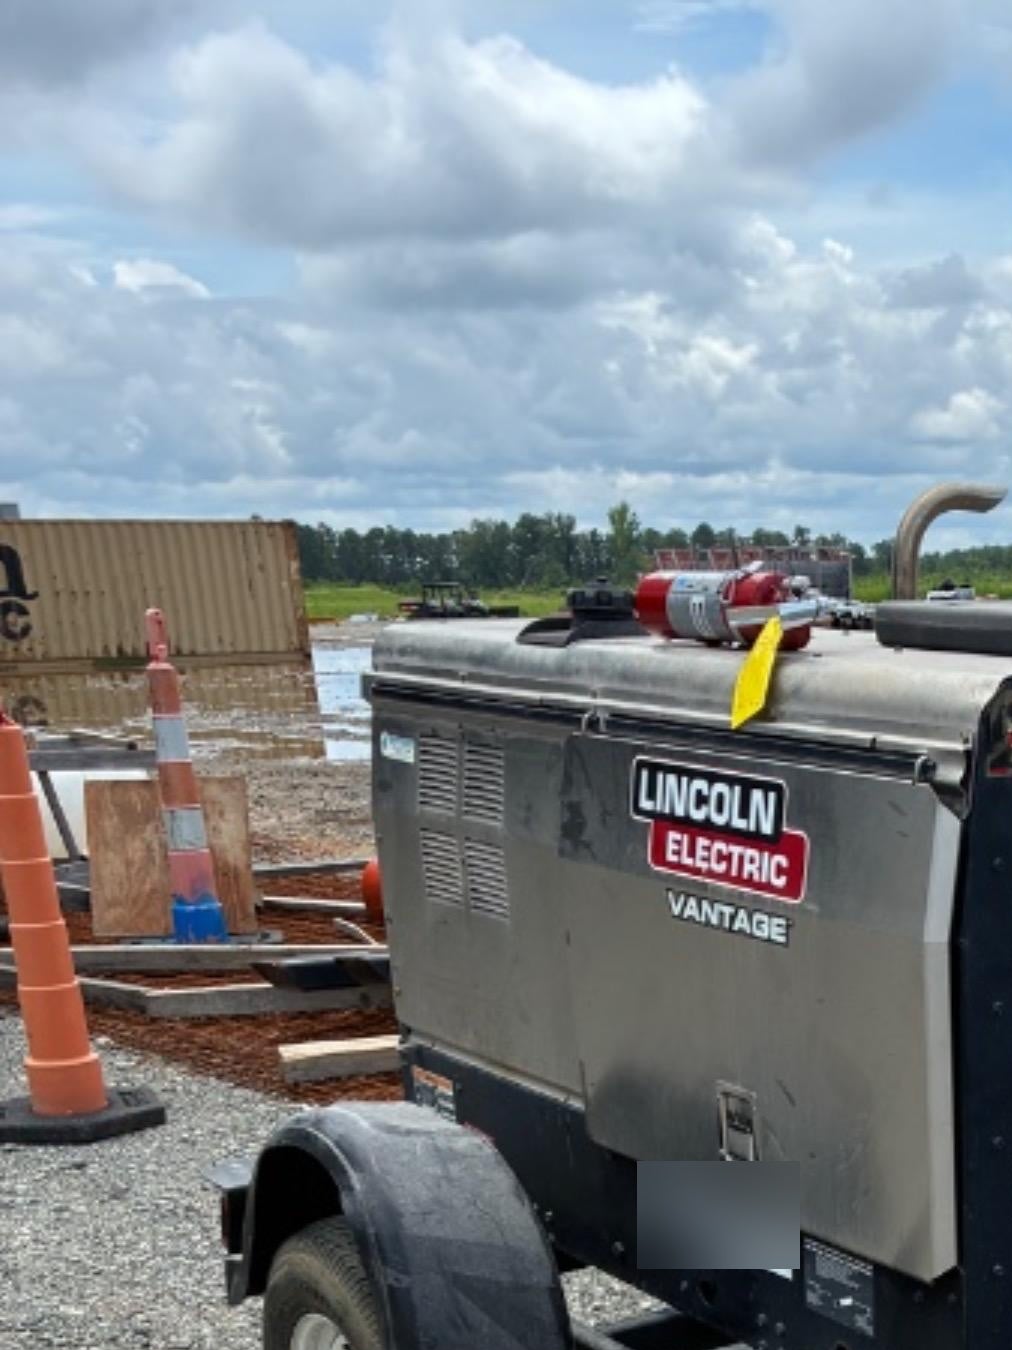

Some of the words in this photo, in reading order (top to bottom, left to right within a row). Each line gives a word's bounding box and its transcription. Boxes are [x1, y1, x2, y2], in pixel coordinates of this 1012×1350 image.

[638, 768, 777, 836] LINCOLN
[665, 830, 788, 887] ELECTRIC
[667, 889, 788, 943] VANTAGE
